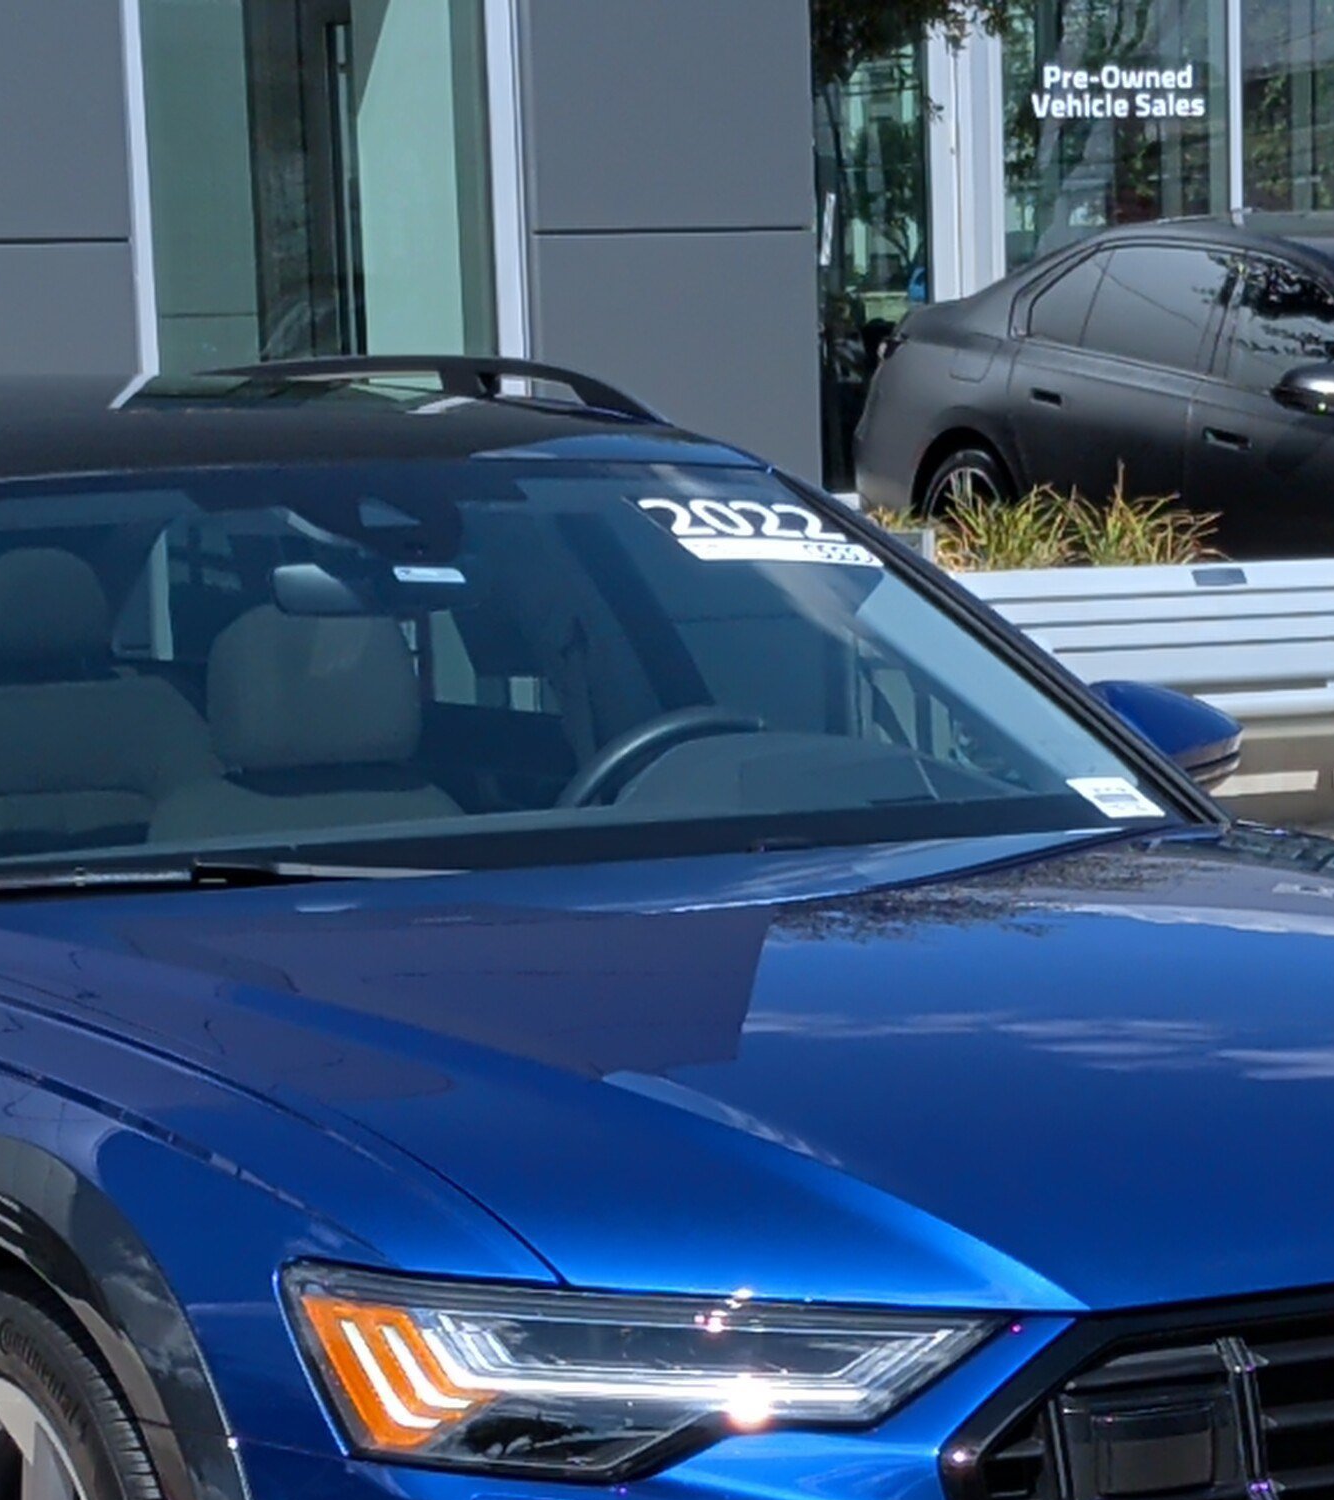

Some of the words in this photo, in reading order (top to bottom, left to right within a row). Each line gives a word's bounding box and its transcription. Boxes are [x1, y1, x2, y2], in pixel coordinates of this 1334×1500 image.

[1043, 64, 1193, 89] Pre-Owned
[1031, 92, 1129, 118] Vehicle
[1135, 93, 1206, 117] Sales
[637, 498, 848, 542] 2022
